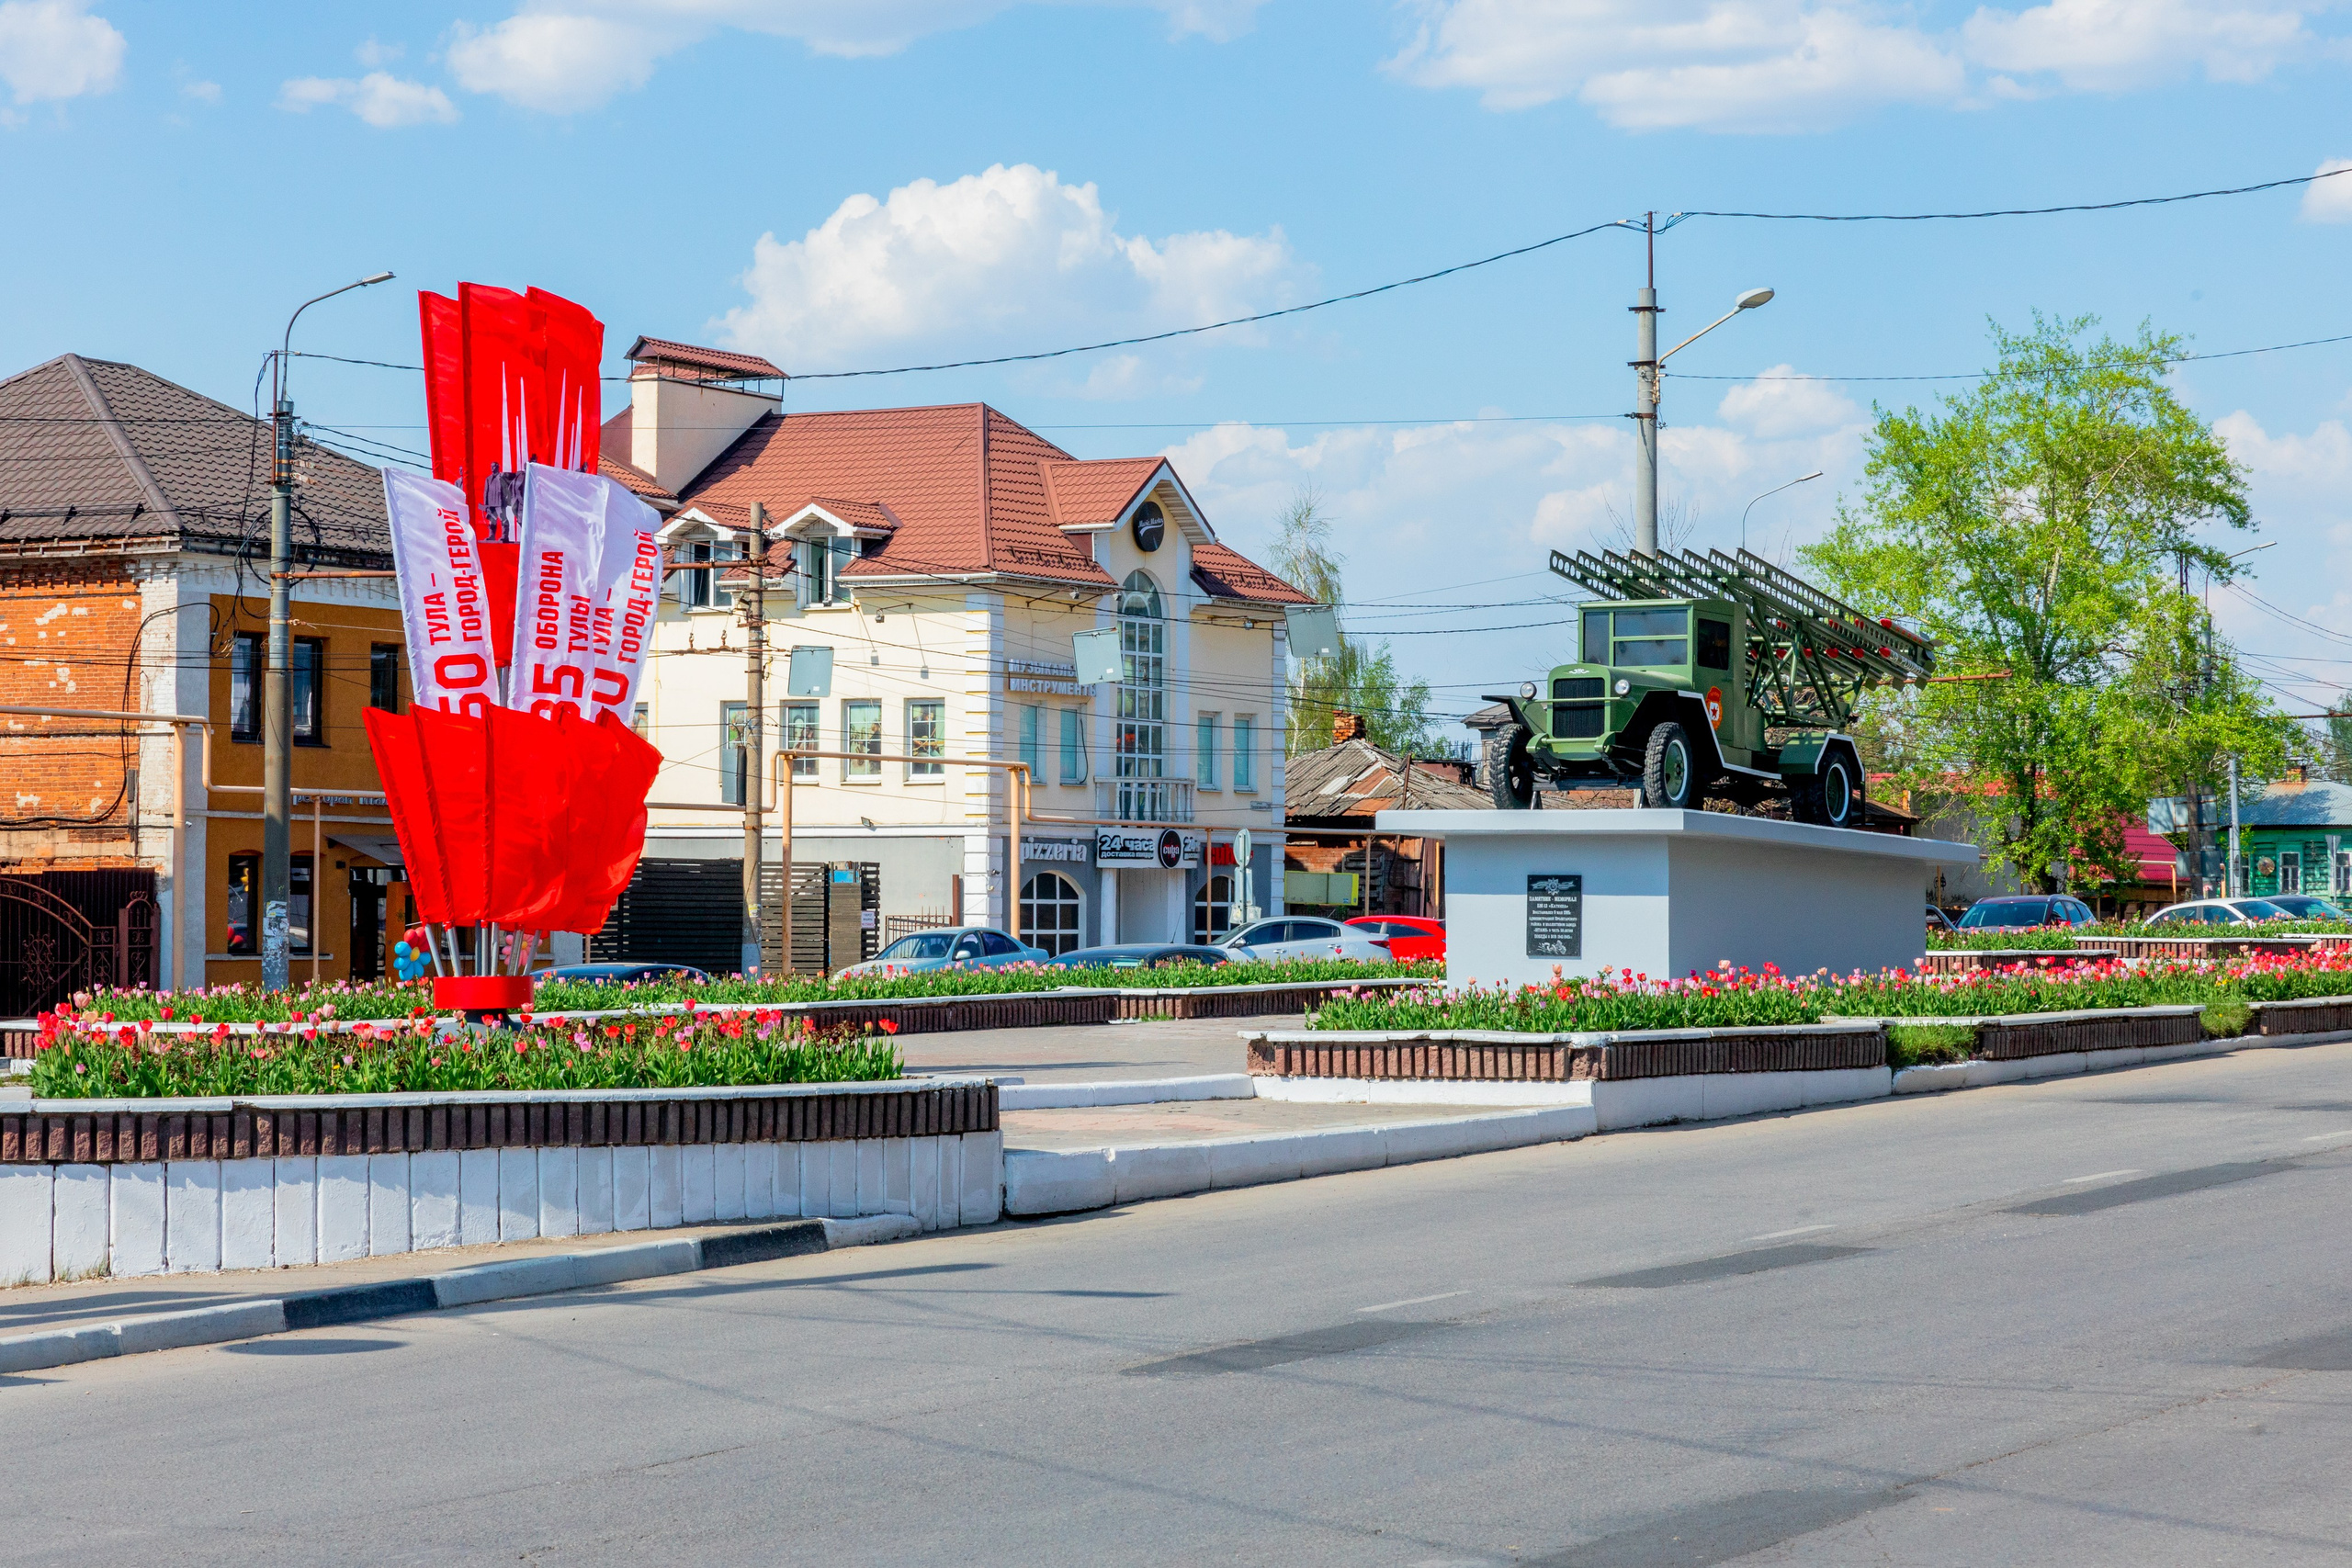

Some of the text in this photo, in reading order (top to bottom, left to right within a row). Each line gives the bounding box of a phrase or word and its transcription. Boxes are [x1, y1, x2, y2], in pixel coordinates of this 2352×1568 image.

[436, 508, 482, 642] ГОРОД-ГЕРОЙ
[535, 551, 563, 649] ОБОРОНА
[616, 527, 658, 664] ГОРОД-ГЕРОЙ
[424, 592, 451, 646] ТУЛА
[568, 594, 591, 653] ТУЛЫ
[1009, 659, 1076, 677] МУЗЫКАЛЬ
[1020, 836, 1087, 863] pizzeria
[1101, 836, 1155, 851] 24 часа
[1163, 845, 1180, 855] cuba
